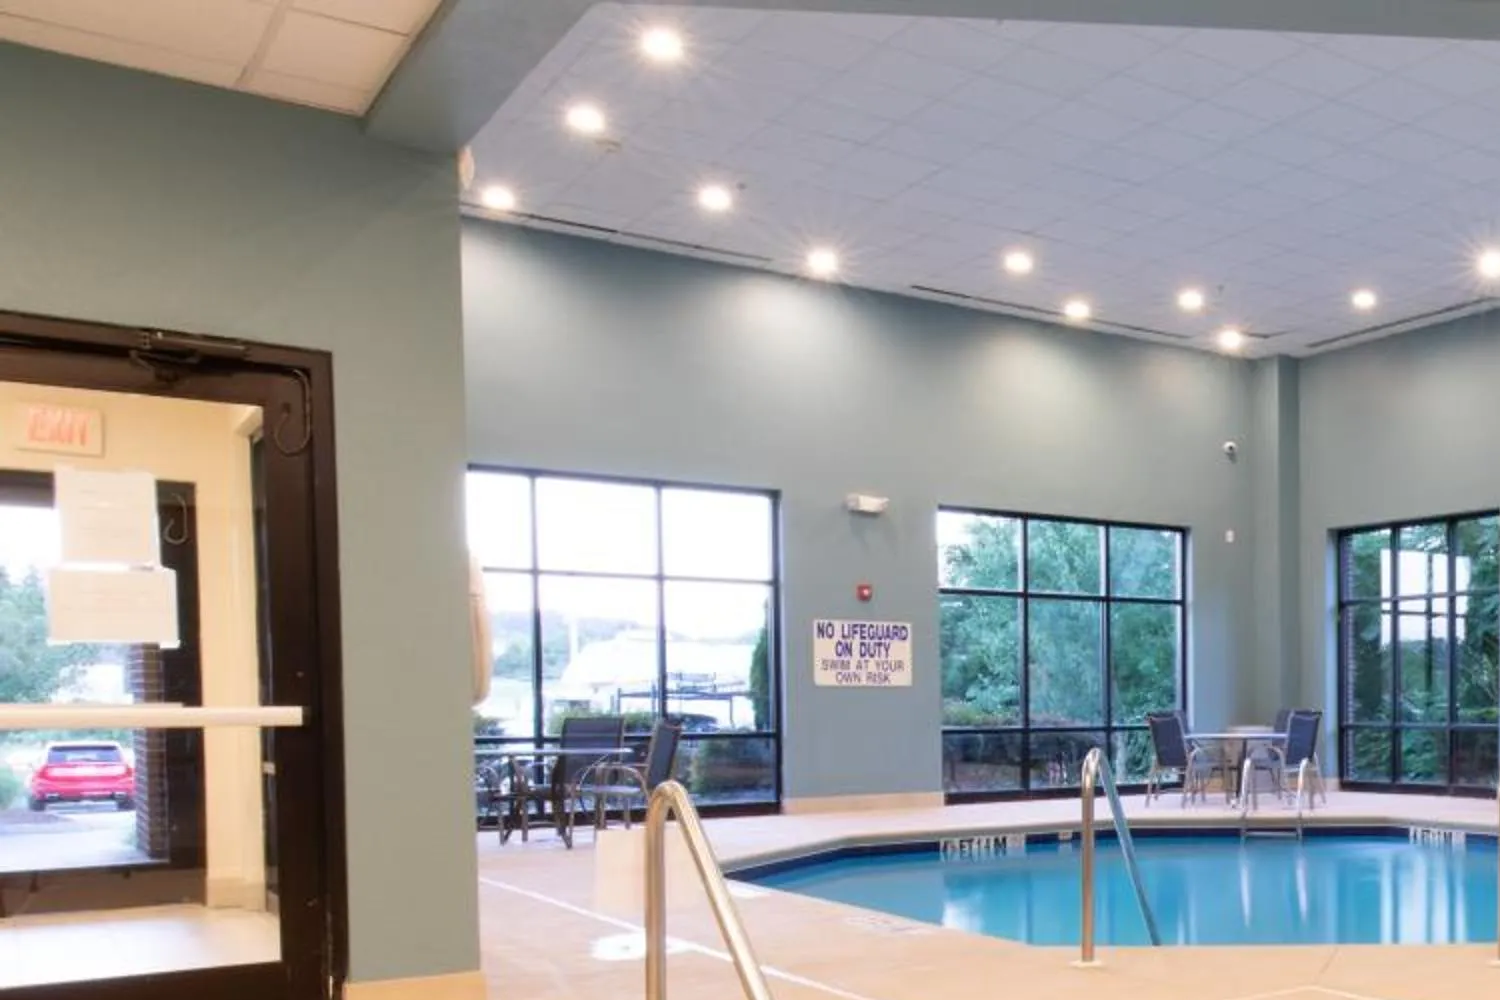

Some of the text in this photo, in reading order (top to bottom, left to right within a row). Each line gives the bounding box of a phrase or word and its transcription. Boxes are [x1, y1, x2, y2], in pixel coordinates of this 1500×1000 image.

[28, 408, 90, 446] EXIT
[817, 622, 909, 641] NO LIFEGUARD
[835, 641, 891, 658] ON DUTY
[821, 659, 905, 672] SWIM AT YOUR
[835, 672, 892, 685] OWN RISK
